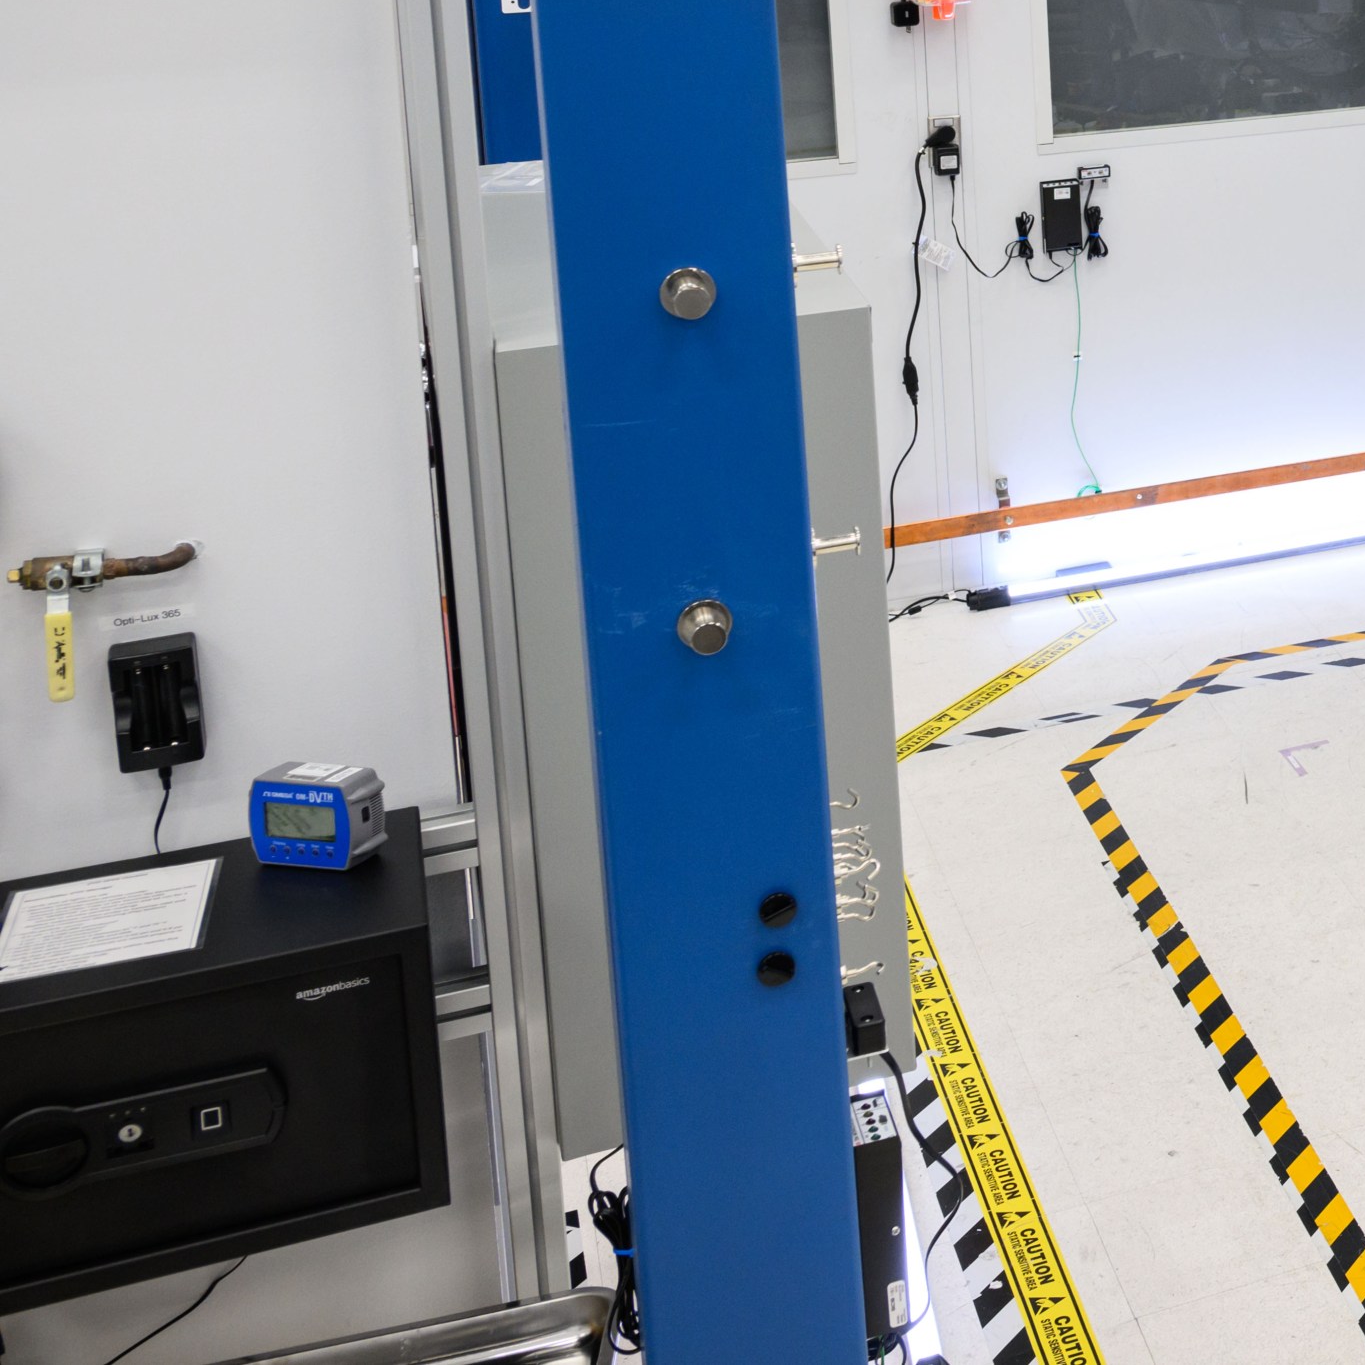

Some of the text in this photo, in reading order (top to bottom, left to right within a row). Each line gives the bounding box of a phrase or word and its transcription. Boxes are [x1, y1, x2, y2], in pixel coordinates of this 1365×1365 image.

[113, 608, 181, 627] Opti-Lux 365
[964, 682, 1010, 712] CAUTION
[296, 977, 370, 1000] amazonbasics
[923, 1013, 934, 1028] STATIC
[935, 1010, 963, 1054] CAUTION
[949, 1079, 976, 1130] STATIC SENSITIVE AREA
[961, 1076, 991, 1124] CAUTION
[976, 1151, 1005, 1206] STATIC SENSITIVE AREA
[989, 1149, 1021, 1200] CAUTION
[1007, 1230, 1039, 1292] STATIC SENSITIVE AREA
[1020, 1227, 1055, 1286] CAUTION
[1041, 1318, 1056, 1339] STATIC
[1054, 1315, 1088, 1365] CAUTIO
